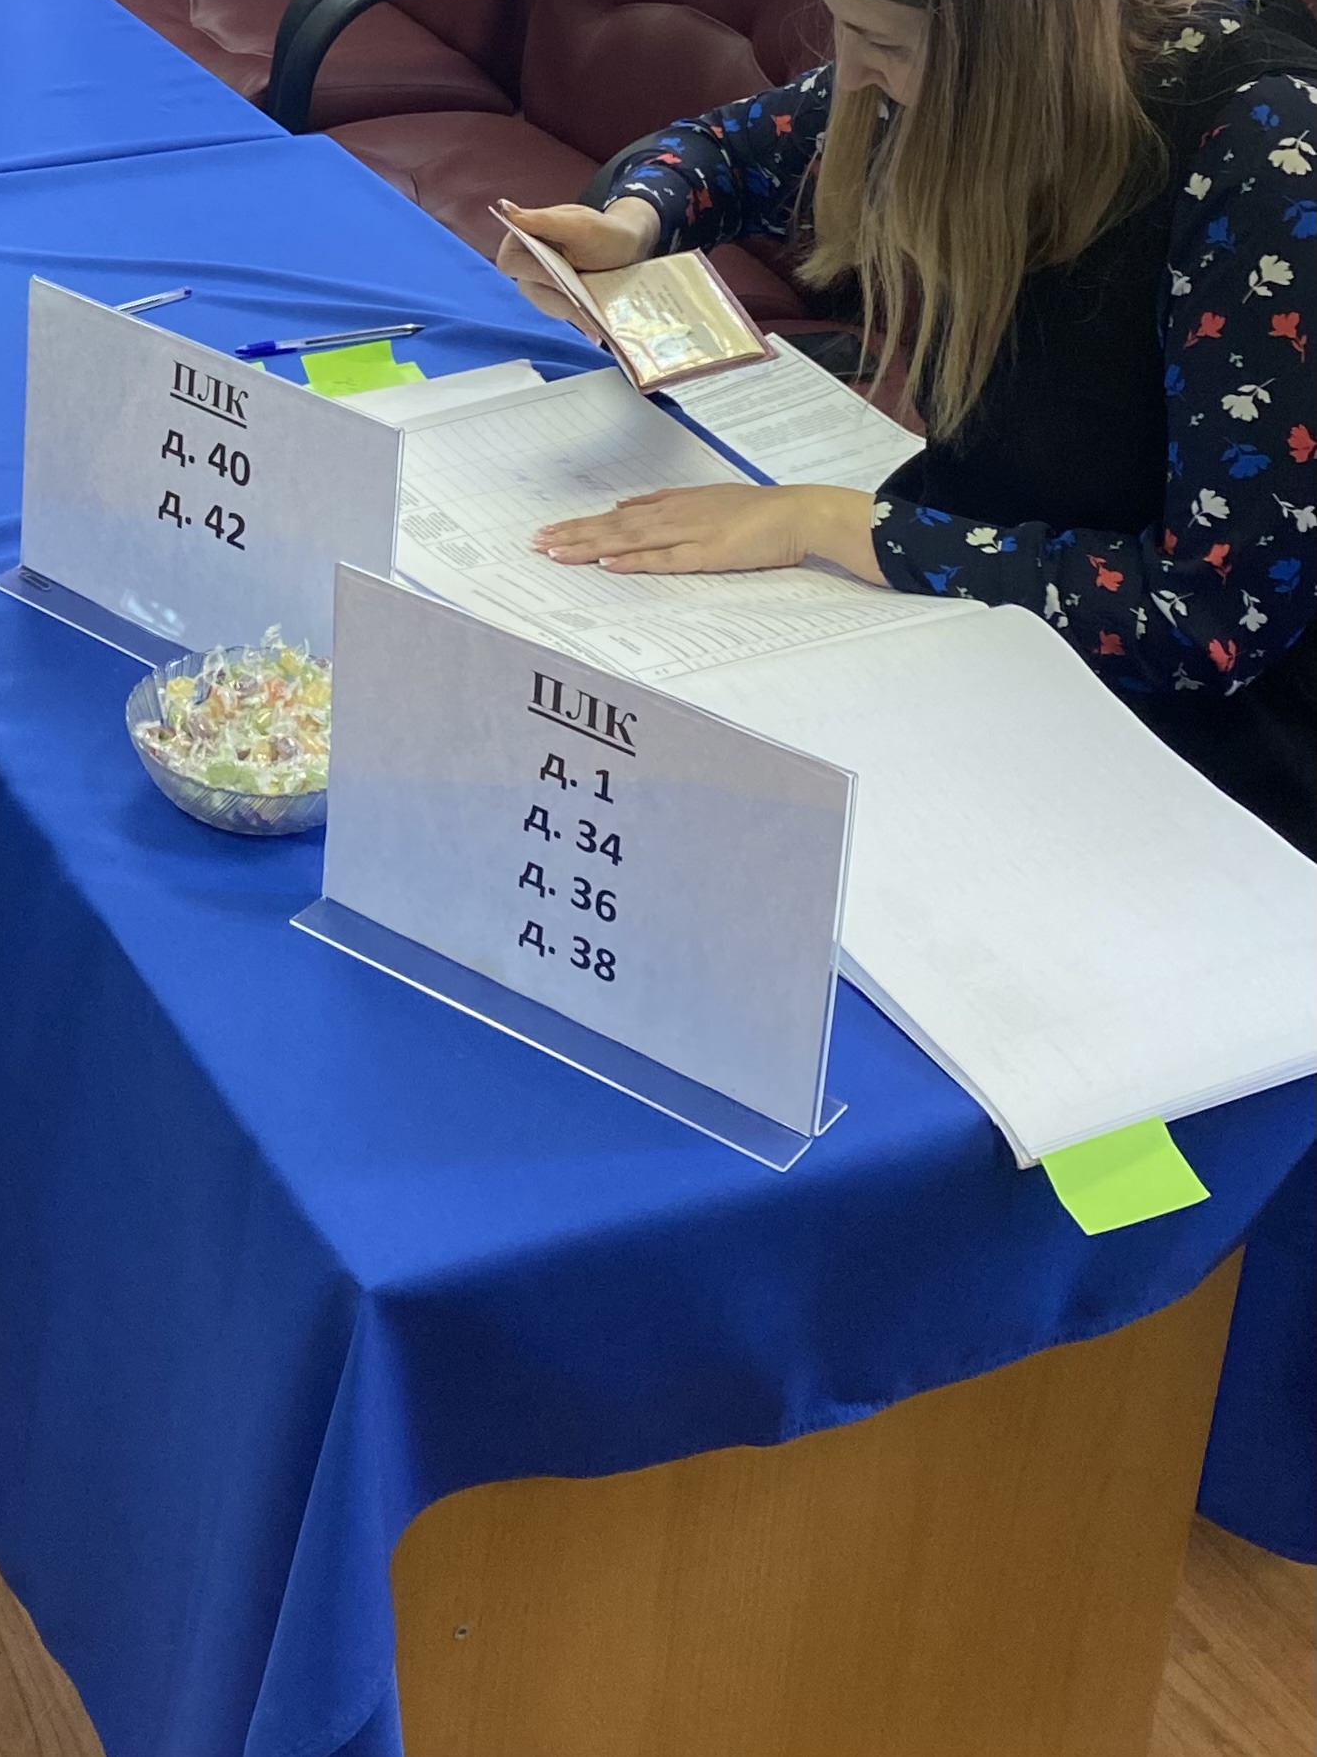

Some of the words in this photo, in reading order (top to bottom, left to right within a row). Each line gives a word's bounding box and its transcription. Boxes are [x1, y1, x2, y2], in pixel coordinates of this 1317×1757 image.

[172, 359, 250, 421] ПЛК
[208, 442, 251, 487] 40
[204, 504, 246, 550] 42
[530, 670, 638, 746] ПЛК
[594, 769, 614, 805] 1
[575, 819, 623, 867] 34
[570, 876, 617, 923] 36
[569, 935, 617, 982] 38
